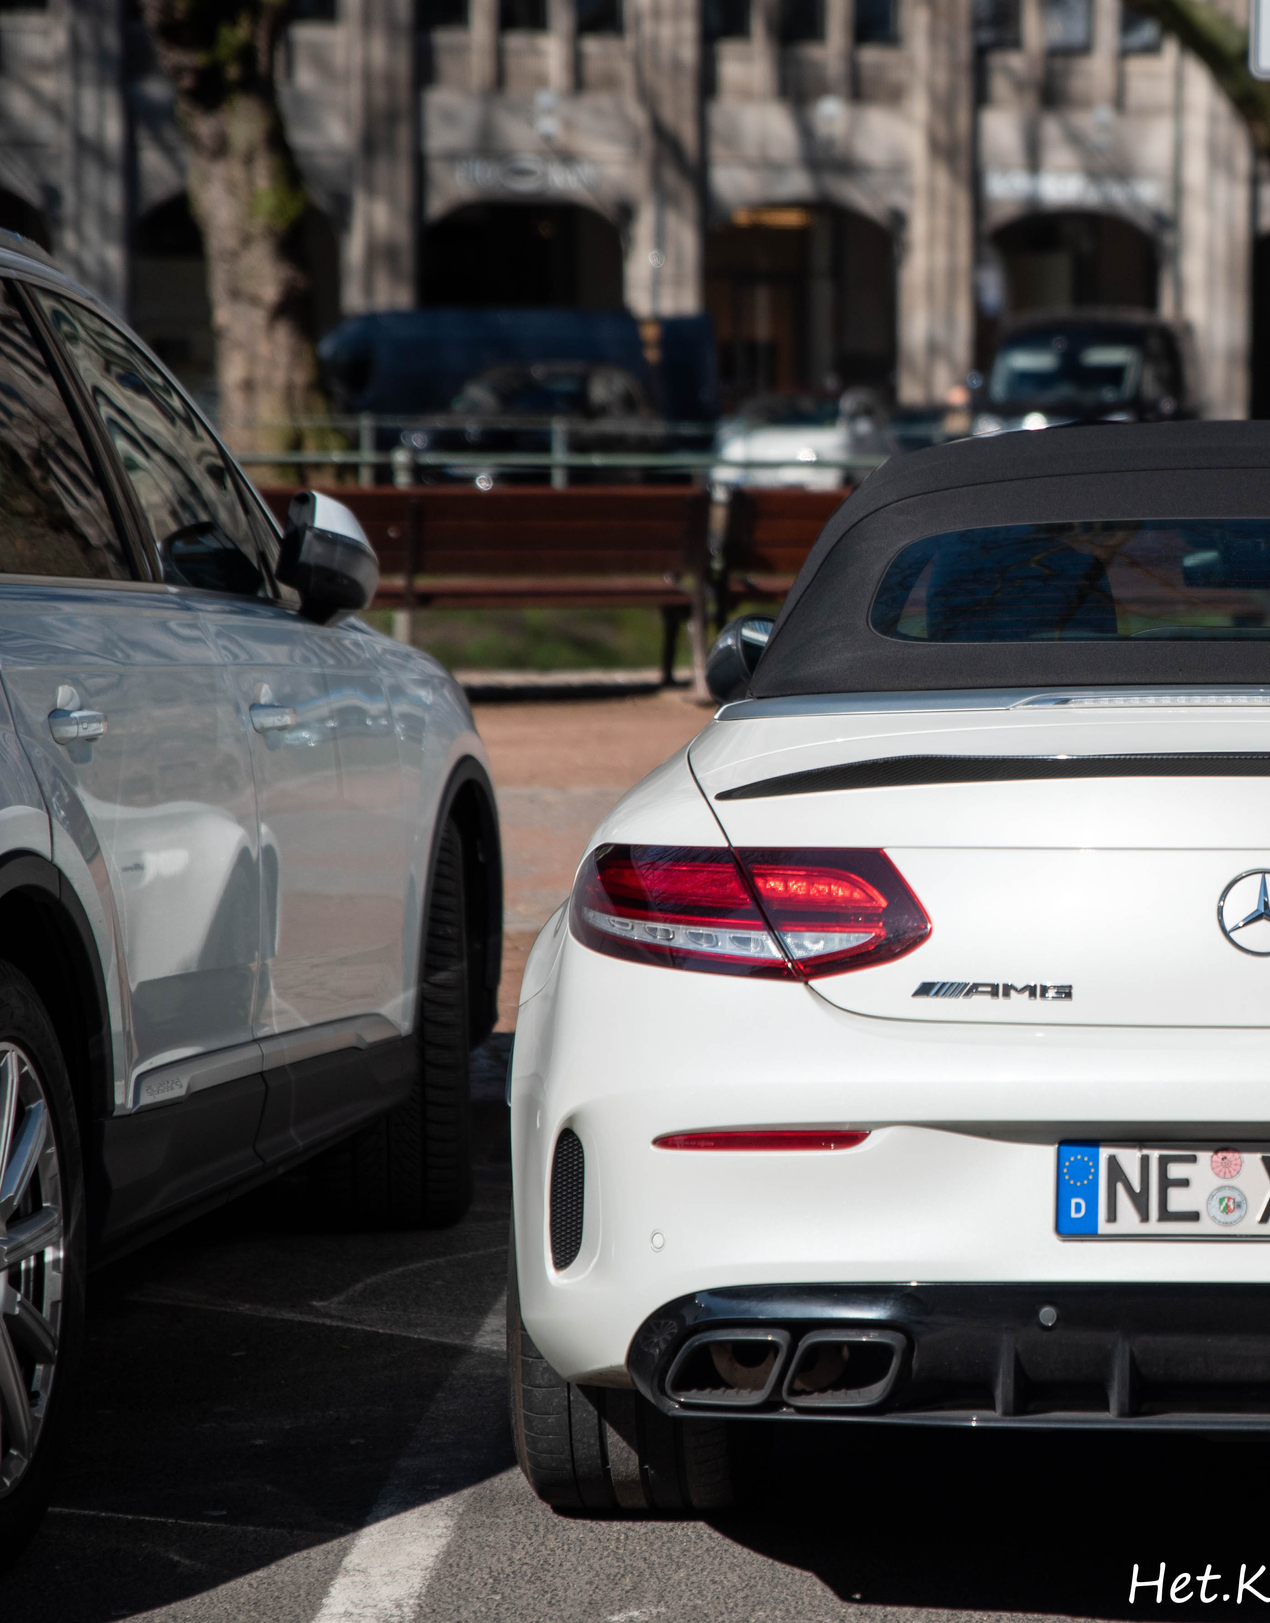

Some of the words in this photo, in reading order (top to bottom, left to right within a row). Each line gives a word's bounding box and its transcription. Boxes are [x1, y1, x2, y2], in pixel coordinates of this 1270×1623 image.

[961, 981, 1073, 1001] AMG
[1070, 1197, 1086, 1219] D
[1105, 1153, 1201, 1224] NE
